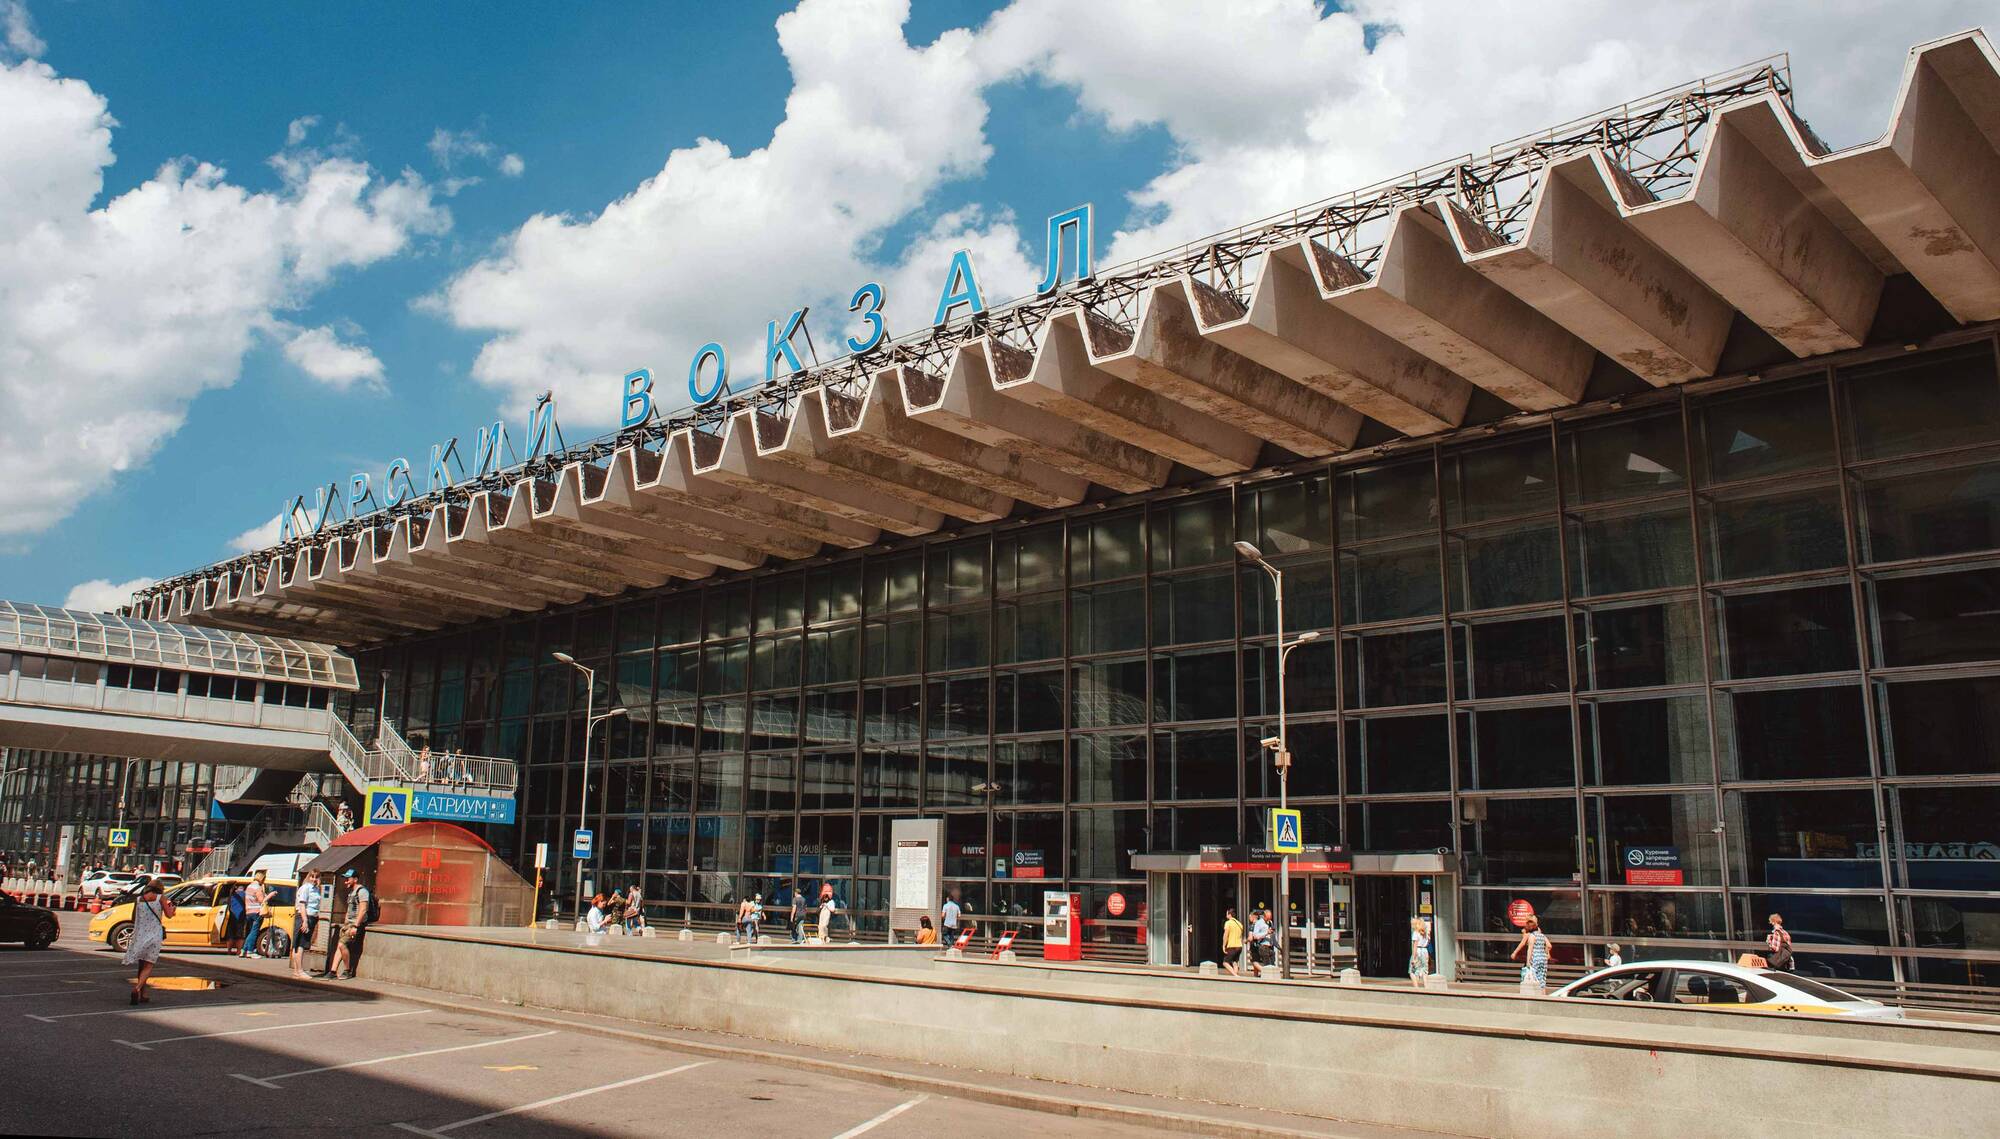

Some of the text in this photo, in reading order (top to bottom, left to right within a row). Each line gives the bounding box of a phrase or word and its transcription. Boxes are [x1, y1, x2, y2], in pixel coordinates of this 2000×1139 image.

[279, 202, 1095, 543] КУРСКИЙ ВОКЗАЛ
[427, 796, 487, 815] АТРИУМ
[775, 844, 828, 854] ONE DOUBE
